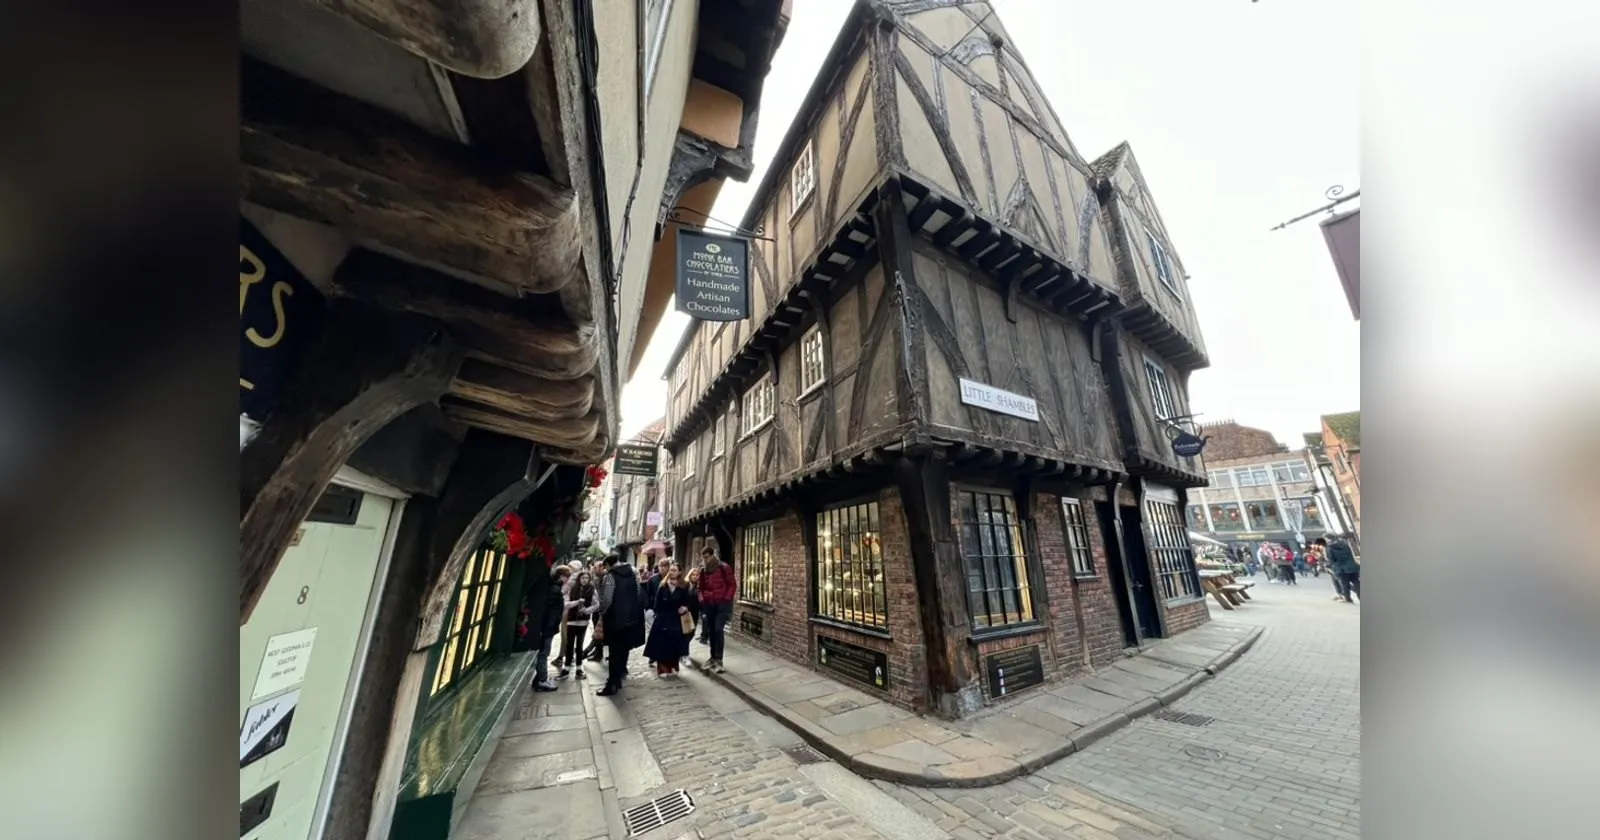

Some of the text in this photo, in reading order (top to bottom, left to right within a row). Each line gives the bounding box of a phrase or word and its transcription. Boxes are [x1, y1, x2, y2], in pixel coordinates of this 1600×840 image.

[693, 251, 733, 265] MONK BAR
[686, 259, 740, 275] CHOCOLATIERS
[687, 277, 740, 292] Handmade
[697, 290, 731, 302] Artisan
[686, 301, 740, 316] Chocolates
[964, 383, 1035, 414] LITTLE SHAMBLES
[297, 585, 309, 605] 8
